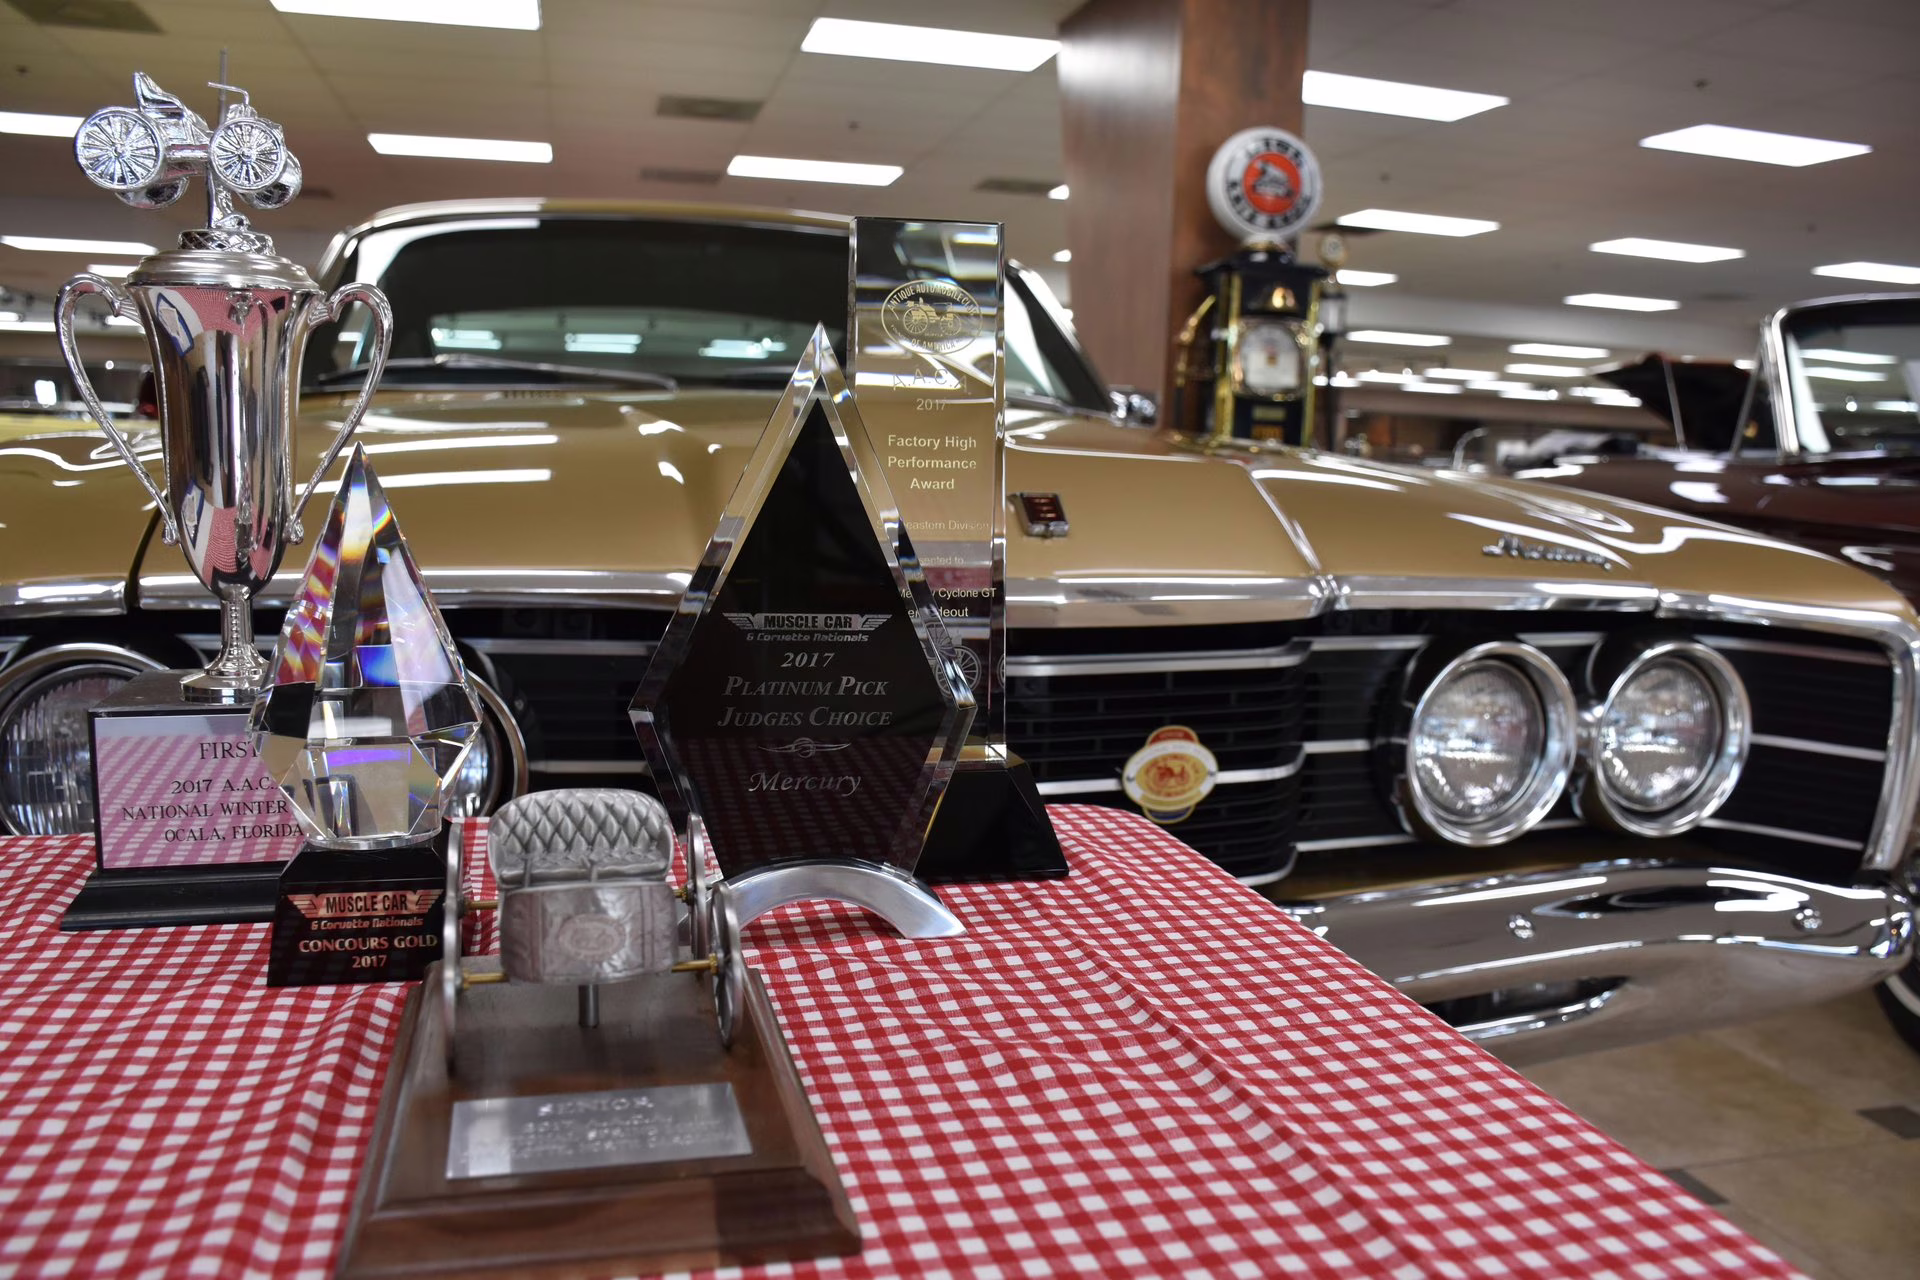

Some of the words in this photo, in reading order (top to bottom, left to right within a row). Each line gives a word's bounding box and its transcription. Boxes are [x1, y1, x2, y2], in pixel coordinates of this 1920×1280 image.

[887, 285, 916, 313] ANTIQUE
[916, 283, 962, 302] AUTOMOBILE
[916, 398, 946, 411] 2017
[888, 434, 941, 450] Factory
[945, 436, 977, 451] High
[888, 455, 977, 469] Performance
[910, 477, 955, 490] Award
[954, 556, 964, 564] to
[938, 587, 979, 600] Cyclone
[981, 587, 997, 598] GT
[763, 615, 818, 629] MUSCLE
[823, 615, 853, 629] CAR
[756, 632, 810, 642] Corvette
[812, 632, 870, 642] Nationals
[780, 652, 836, 668] 2017
[721, 675, 833, 696] PLATINUM
[834, 675, 889, 696] PICK
[717, 705, 804, 727] JUDGES
[808, 705, 893, 727] CHOICE
[171, 779, 213, 795] 2017
[222, 776, 280, 793] A.A.C.
[748, 771, 862, 797] Mercury
[122, 803, 214, 821] NATIONAL
[220, 800, 289, 816] WINTER
[164, 827, 226, 843] OCALA,
[232, 823, 305, 839] FLORIDA
[325, 895, 378, 914] MUSCLE
[382, 894, 409, 911] CAR
[320, 919, 369, 930] Corvette
[372, 916, 424, 928] Nationals
[298, 936, 390, 953] CONCOURS
[393, 934, 438, 949] GOLD
[351, 954, 388, 969] 2017
